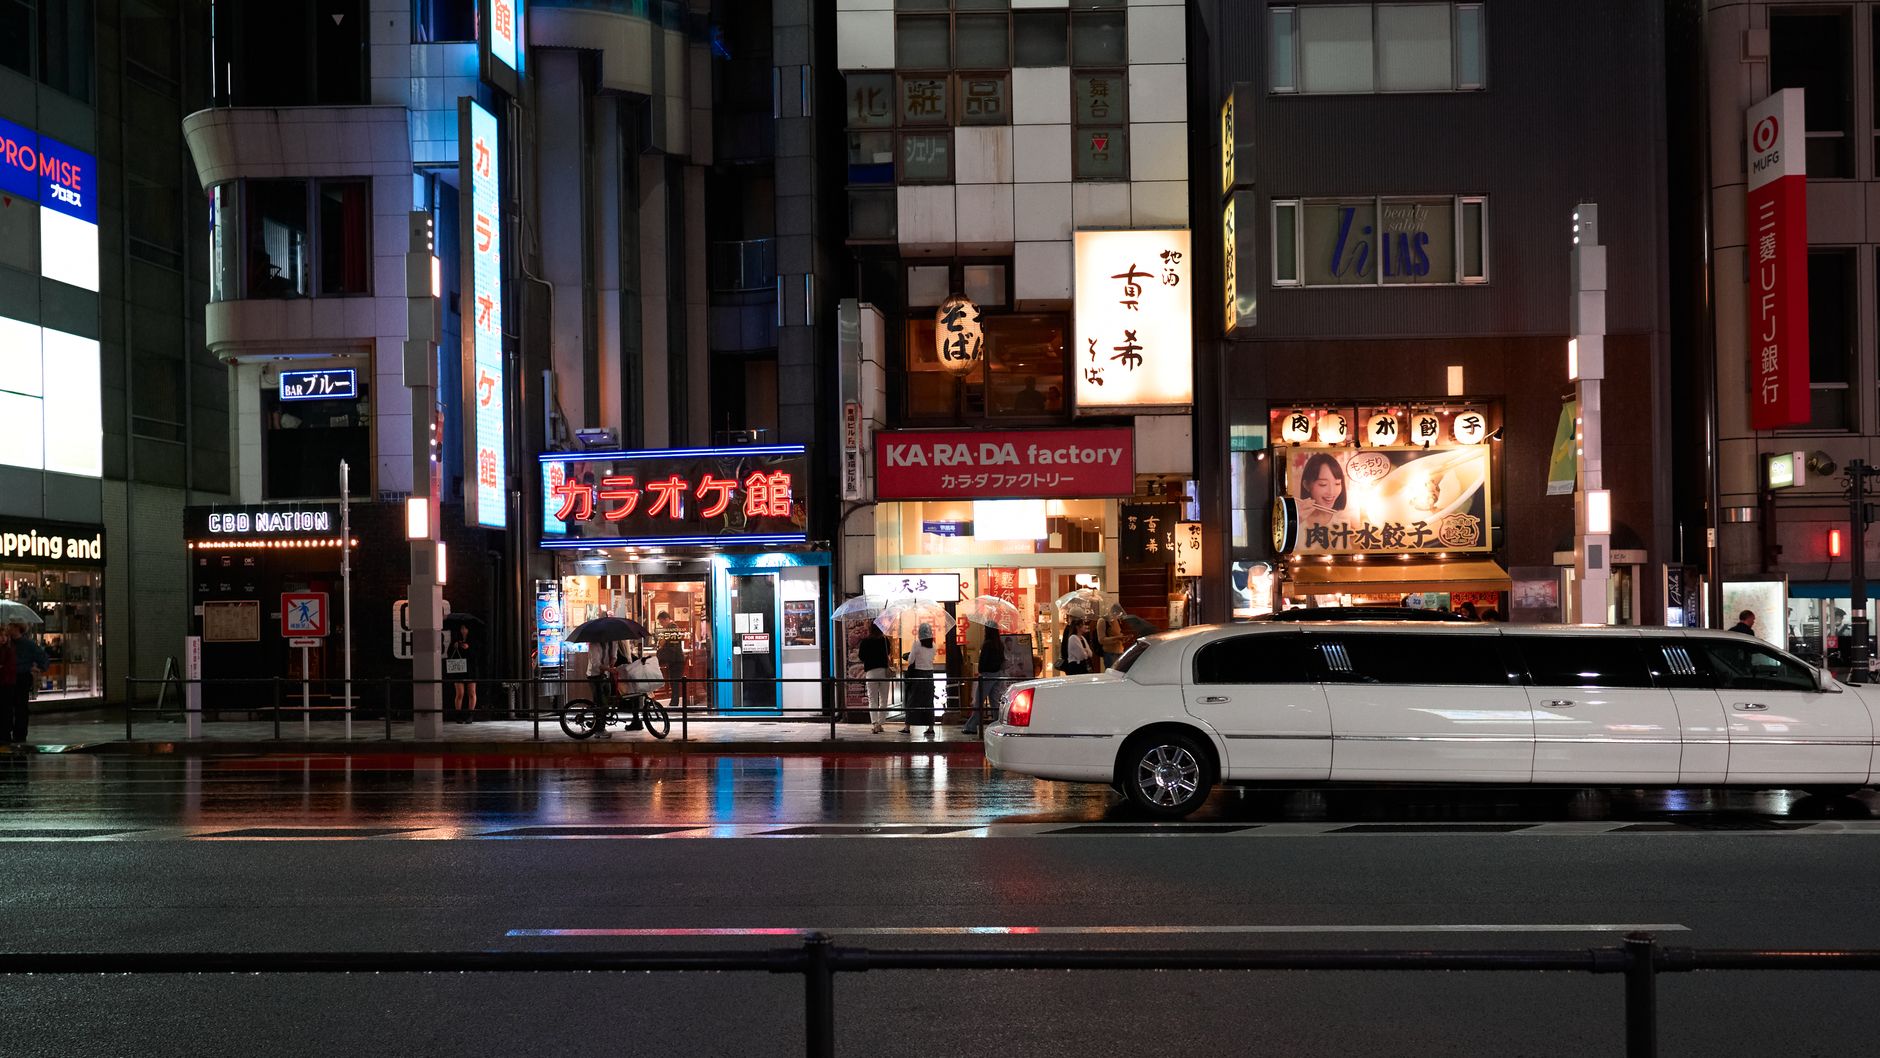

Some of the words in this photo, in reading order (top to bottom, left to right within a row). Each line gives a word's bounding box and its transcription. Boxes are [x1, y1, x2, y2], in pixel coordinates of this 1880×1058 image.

[856, 80, 1001, 119] 化粧品
[1752, 150, 1780, 175] MUFG
[50, 183, 82, 208] プロミス
[1384, 205, 1430, 219] beauty
[1388, 220, 1425, 231] salon
[1160, 249, 1182, 287] 地酒
[474, 138, 498, 490] カラオケ館
[1110, 262, 1155, 371] 真希
[1759, 199, 1779, 405] 三菱UFJ銀行
[941, 303, 974, 362] そば
[1084, 337, 1105, 387] そば
[284, 384, 303, 397] BAR
[302, 374, 352, 395] ブルー
[1027, 444, 1124, 466] factory
[554, 471, 793, 521] カラオケ館
[209, 514, 250, 532] CBD
[256, 511, 329, 531] NATION
[1305, 521, 1433, 550] 肉汁水餃子
[0, 529, 63, 559] pping
[66, 533, 101, 560] and
